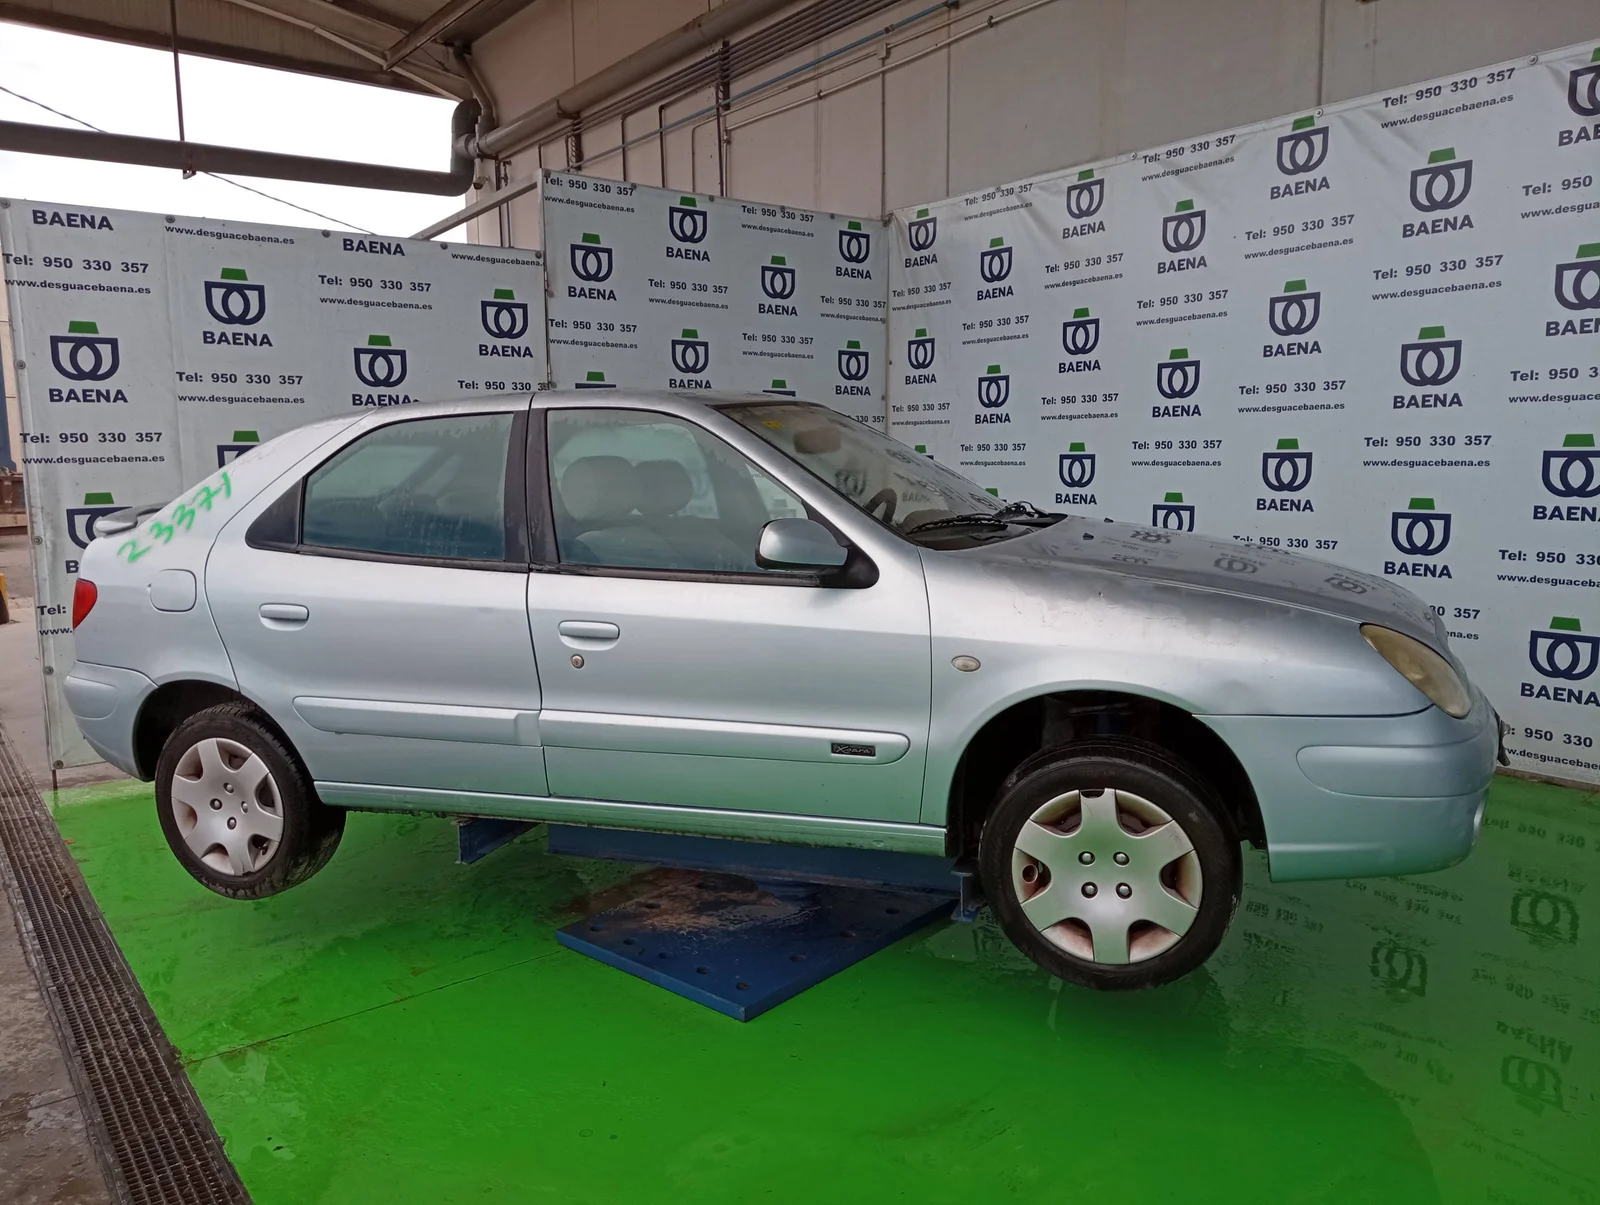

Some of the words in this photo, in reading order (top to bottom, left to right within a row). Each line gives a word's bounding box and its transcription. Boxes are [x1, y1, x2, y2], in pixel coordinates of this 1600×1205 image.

[1382, 94, 1408, 108] Tel:
[1415, 85, 1442, 101] 950
[1450, 76, 1478, 93] 330
[1486, 67, 1516, 85] 357
[1380, 94, 1514, 129] www.desguacebaena.es
[1142, 152, 1161, 164] Tel:
[1165, 146, 1185, 159] 950
[1190, 140, 1210, 154] 330
[1215, 134, 1236, 148] 357
[1141, 156, 1235, 182] www.desguacebaena.es
[544, 175, 563, 187] Tel:
[568, 179, 588, 190] 950
[592, 182, 612, 194] 330
[616, 185, 635, 197] 357
[1270, 176, 1331, 200] BAENA
[1522, 182, 1552, 197] Tel:
[1561, 175, 1593, 191] 950
[543, 195, 635, 213] www.desguacebaena.es
[32, 209, 114, 231] BAENA
[760, 207, 777, 218] 950
[780, 210, 796, 220] 330
[799, 213, 815, 223] 357
[1062, 220, 1106, 240] BAENA
[1244, 229, 1267, 241] Tel:
[1272, 223, 1295, 237] 950
[1301, 219, 1325, 232] 330
[1331, 213, 1355, 227] 357
[1402, 214, 1474, 239] BAENA
[164, 225, 295, 245] www.desguacebaena.es
[342, 238, 406, 257] BAENA
[666, 246, 711, 262] BAENA
[1244, 237, 1354, 260] www.desguacebaena.es
[1, 252, 34, 266] Tel:
[42, 256, 73, 269] 950
[82, 259, 112, 272] 330
[120, 261, 149, 274] 357
[904, 253, 938, 269] BAENA
[1063, 259, 1081, 271] 950
[1084, 256, 1102, 268] 330
[1106, 252, 1124, 264] 357
[1157, 255, 1208, 275] BAENA
[1372, 268, 1398, 281] Tel:
[1405, 263, 1432, 277] 950
[1439, 259, 1467, 273] 330
[1475, 254, 1504, 268] 357
[835, 266, 872, 280] BAENA
[4, 279, 151, 294] www.desguacebaena.es
[318, 274, 343, 286] Tel:
[349, 277, 373, 288] 950
[380, 279, 403, 291] 330
[409, 281, 432, 292] 357
[647, 278, 666, 289] Tel:
[669, 280, 687, 291] 950
[691, 282, 708, 293] 330
[712, 284, 729, 294] 357
[1371, 280, 1502, 301] www.desguacebaena.es
[567, 285, 617, 302] BAENA
[976, 285, 1014, 301] BAENA
[1136, 299, 1155, 310] Tel:
[1159, 295, 1179, 307] 950
[1183, 292, 1203, 304] 330
[1208, 289, 1229, 301] 357
[319, 297, 433, 311] www.desguacebaena.es
[758, 303, 798, 317] BAENA
[548, 318, 568, 329] Tel:
[572, 320, 592, 330] 950
[596, 322, 615, 332] 330
[619, 323, 638, 333] 357
[978, 319, 994, 329] 950
[996, 317, 1011, 327] 330
[1014, 314, 1030, 325] 357
[1135, 311, 1228, 326] www.desguacebaena.es
[202, 330, 273, 347] BAENA
[548, 338, 638, 350] www.desguacebaena.es
[741, 332, 758, 342] Tel:
[761, 333, 777, 343] 950
[780, 335, 796, 344] 330
[798, 336, 814, 345] 357
[478, 343, 534, 358] BAENA
[1262, 340, 1322, 358] BAENA
[1058, 359, 1102, 374] BAENA
[175, 371, 203, 383] Tel:
[211, 372, 238, 384] 950
[245, 373, 271, 385] 330
[278, 374, 303, 385] 357
[905, 373, 937, 386] BAENA
[1510, 369, 1539, 382] Tel:
[1548, 367, 1579, 380] 950
[457, 380, 479, 390] Tel:
[484, 380, 506, 391] 950
[511, 381, 532, 391] 330
[669, 378, 712, 390] BAENA
[835, 385, 871, 396] BAENA
[1238, 385, 1260, 395] Tel:
[1265, 383, 1287, 394] 950
[1293, 381, 1316, 393] 330
[1322, 380, 1346, 391] 357
[48, 388, 129, 403] BAENA
[177, 394, 305, 405] www.desguacebaena.es
[351, 393, 412, 407] BAENA
[1060, 395, 1077, 405] 950
[1081, 394, 1098, 404] 330
[1102, 392, 1119, 403] 357
[1392, 392, 1463, 410] BAENA
[1152, 404, 1202, 418] BAENA
[1237, 403, 1345, 414] www.desguacebaena.es
[974, 412, 1011, 425] BAENA
[19, 432, 50, 444] Tel:
[58, 432, 89, 444] 950
[97, 432, 127, 443] 330
[135, 432, 163, 443] 357
[1131, 441, 1150, 450] Tel:
[1154, 440, 1173, 450] 950
[1178, 440, 1197, 450] 330
[1202, 439, 1223, 449] 357
[1363, 436, 1388, 447] Tel:
[1395, 436, 1422, 447] 950
[1429, 435, 1456, 447] 330
[1464, 435, 1492, 446] 357
[976, 443, 991, 452] 950
[994, 443, 1009, 452] 330
[1011, 443, 1027, 452] 357
[21, 454, 165, 466] www.desguacebaena.es
[1131, 459, 1222, 468] www.desguacebaena.es
[1362, 458, 1491, 469] www.desguacebaena.es
[1055, 493, 1098, 505] BAENA
[1256, 498, 1315, 513] BAENA
[117, 471, 232, 563] 23371
[1532, 505, 1600, 523] BAEN
[1259, 536, 1281, 547] 950
[1286, 538, 1309, 549] 330
[1315, 539, 1338, 550] 357
[1498, 549, 1527, 562] Tel:
[1536, 551, 1566, 564] 950
[1383, 561, 1453, 579] BAENA
[36, 604, 67, 616] Tel:
[1453, 607, 1481, 620] 357
[1520, 682, 1600, 708] BAENA
[1524, 727, 1554, 742] 950
[1562, 733, 1593, 748] 330
